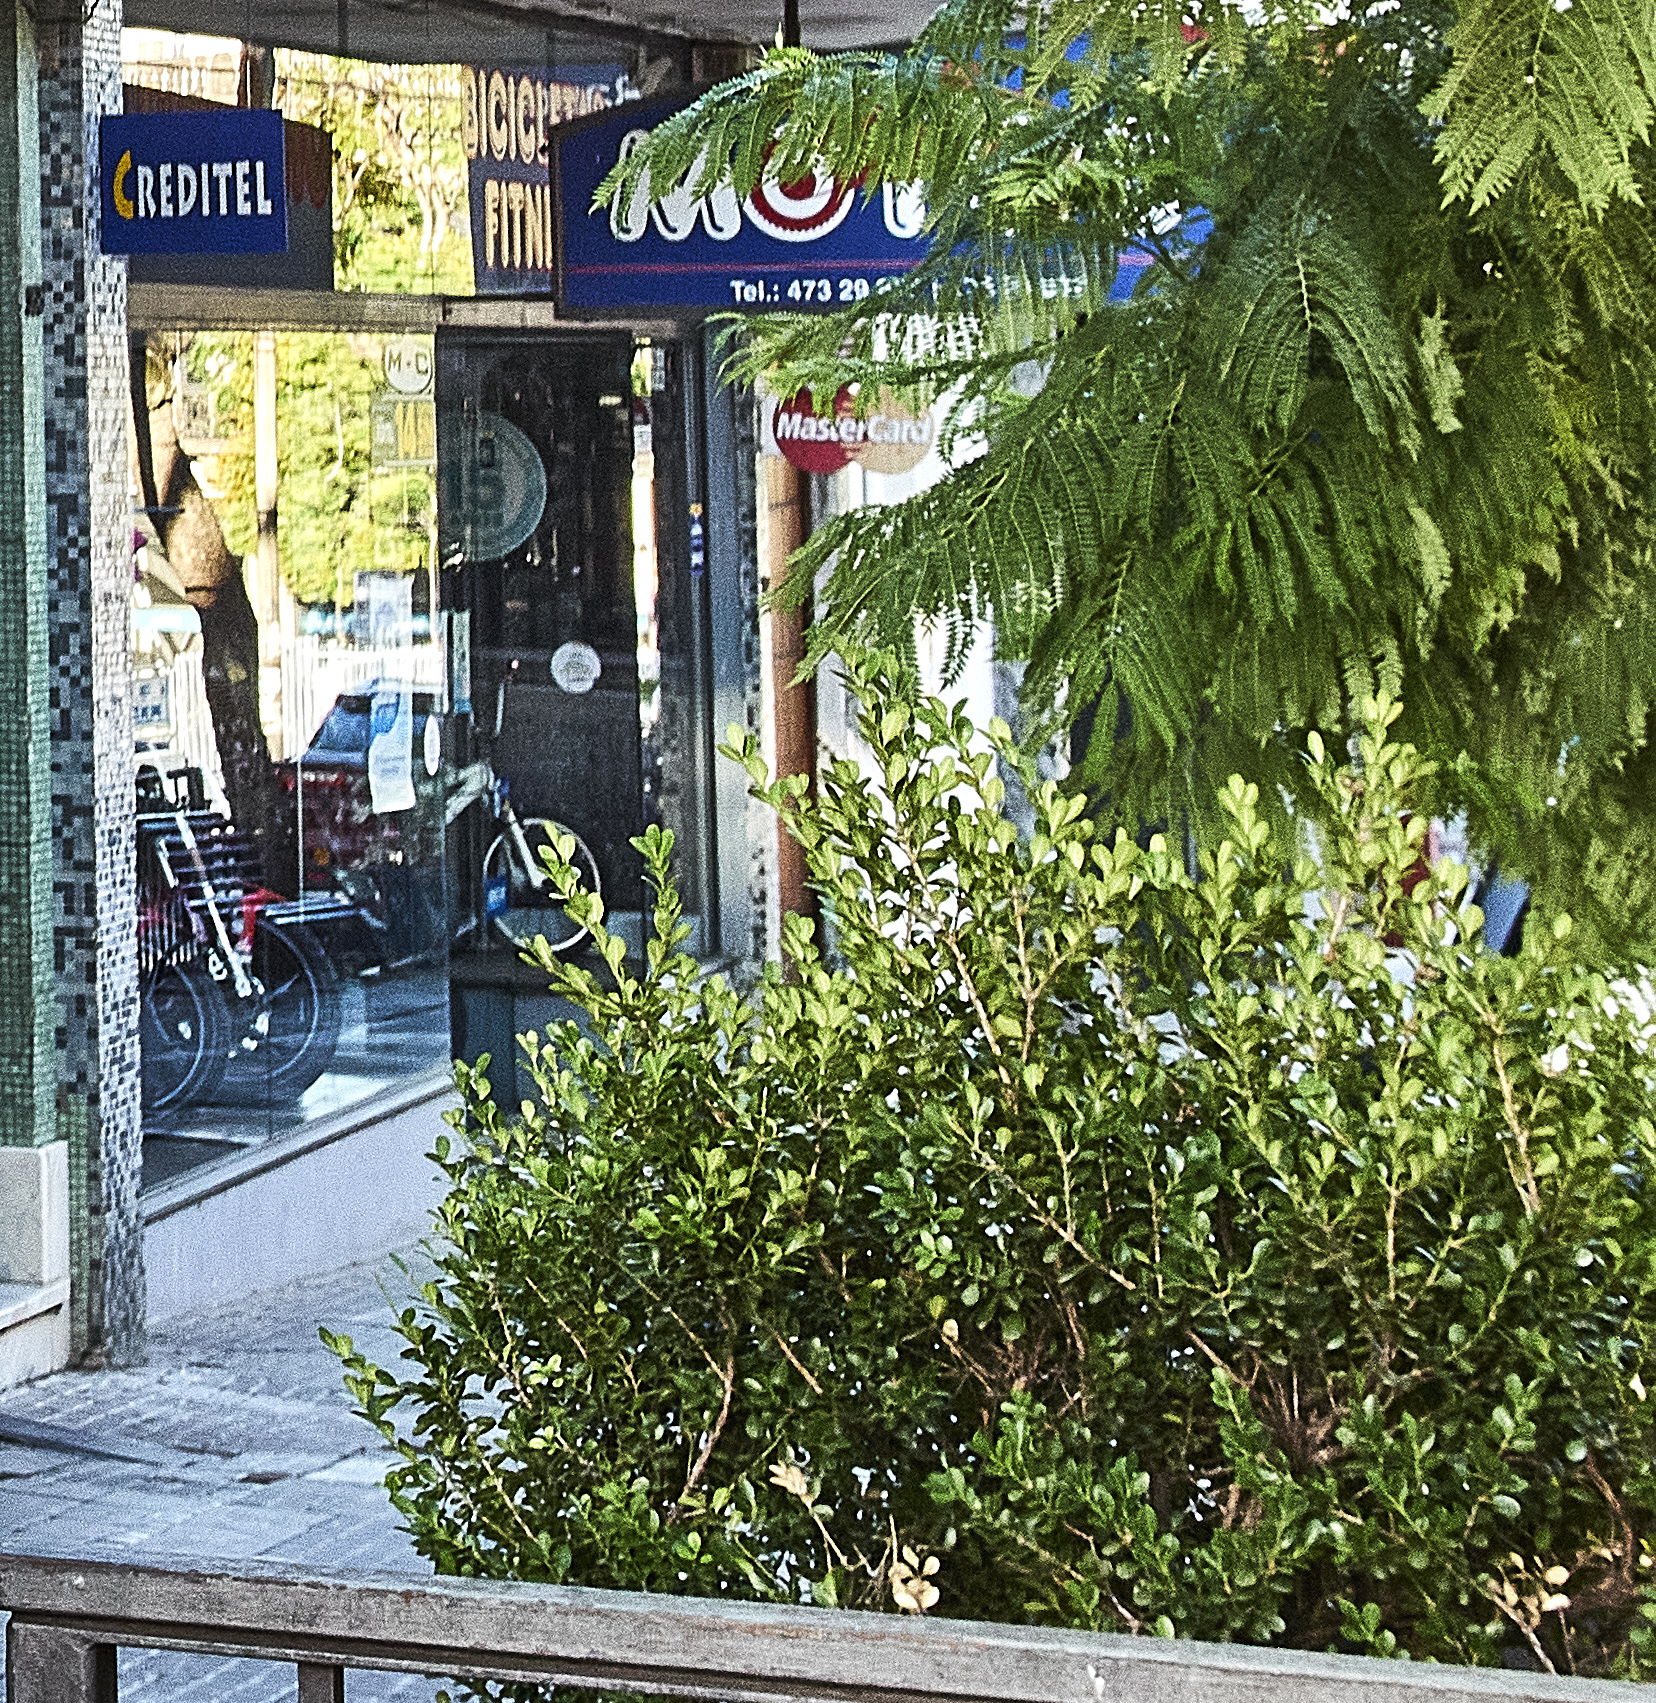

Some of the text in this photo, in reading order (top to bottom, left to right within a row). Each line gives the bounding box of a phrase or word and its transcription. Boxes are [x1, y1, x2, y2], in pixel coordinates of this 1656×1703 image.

[113, 150, 272, 219] CREDITEL
[730, 279, 780, 303] Tel.:
[787, 279, 833, 302] 473
[776, 412, 930, 442] MasterCard
